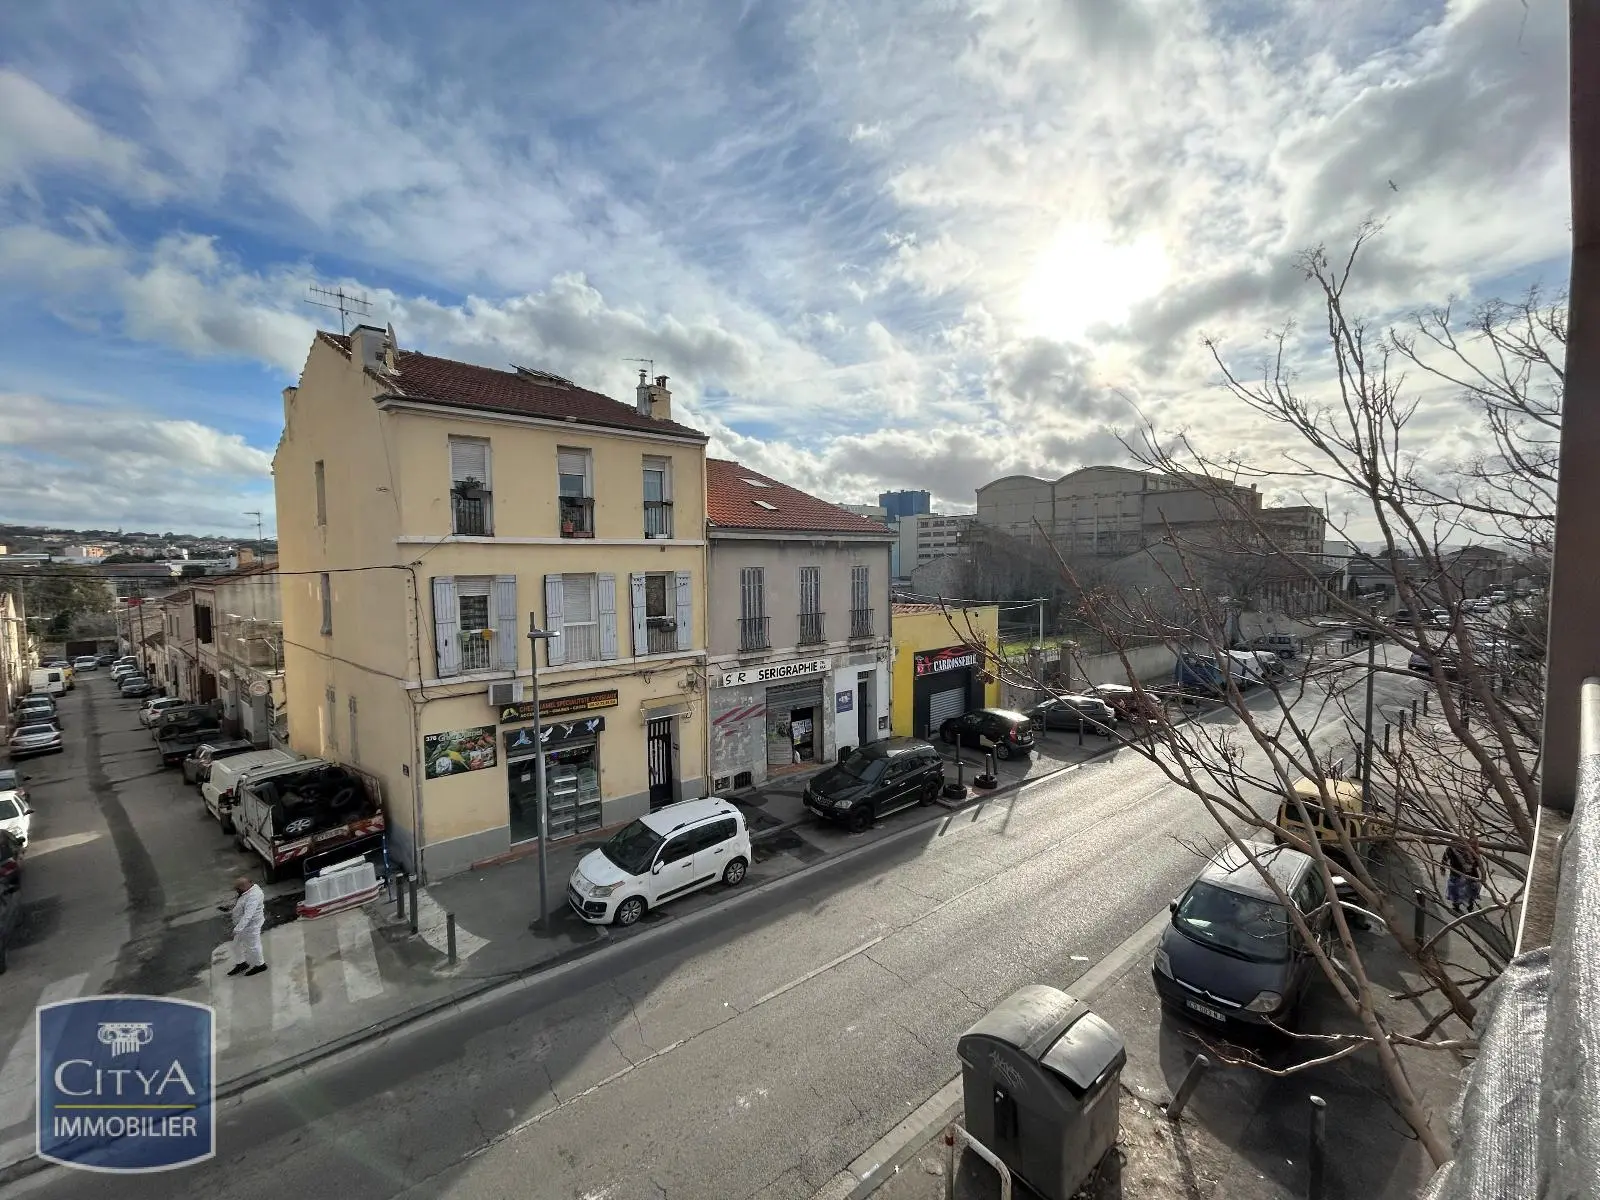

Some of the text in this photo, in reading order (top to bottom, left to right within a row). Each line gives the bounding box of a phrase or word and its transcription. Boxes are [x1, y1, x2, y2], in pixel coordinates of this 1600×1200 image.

[725, 661, 818, 686] S R SERIGRAPHIE
[934, 653, 978, 672] CARROSSERIE
